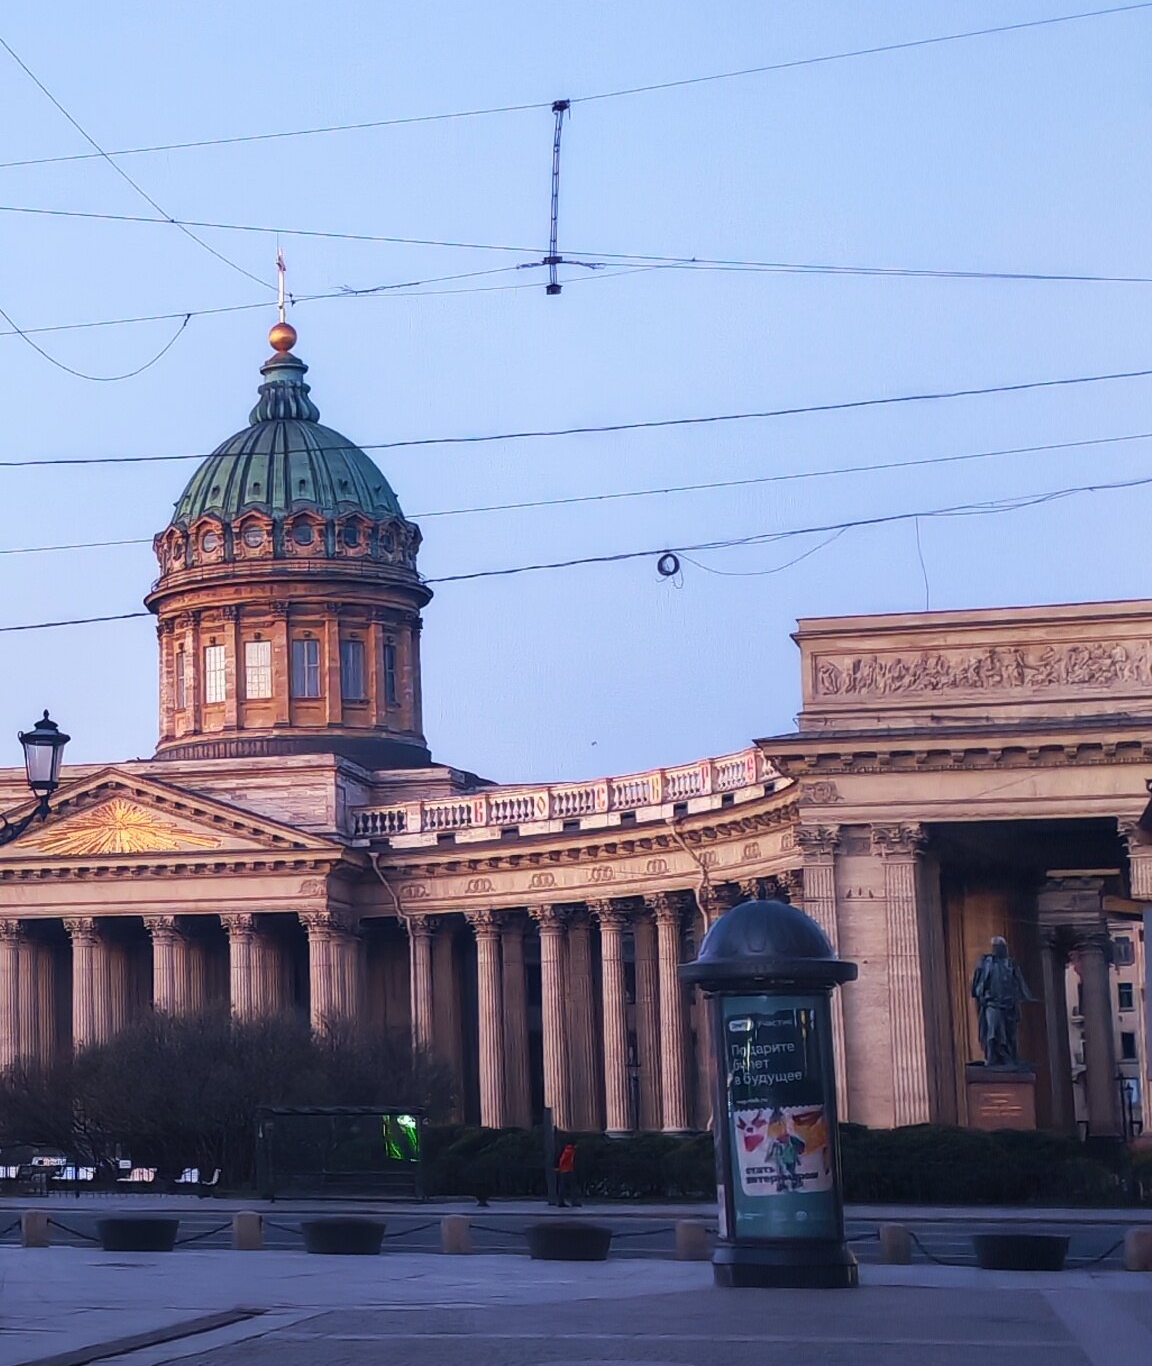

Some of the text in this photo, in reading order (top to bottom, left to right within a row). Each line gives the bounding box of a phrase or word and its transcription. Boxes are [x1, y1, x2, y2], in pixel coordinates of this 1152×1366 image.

[731, 1042, 795, 1057] Подарите
[734, 1072, 802, 1087] в будущее
